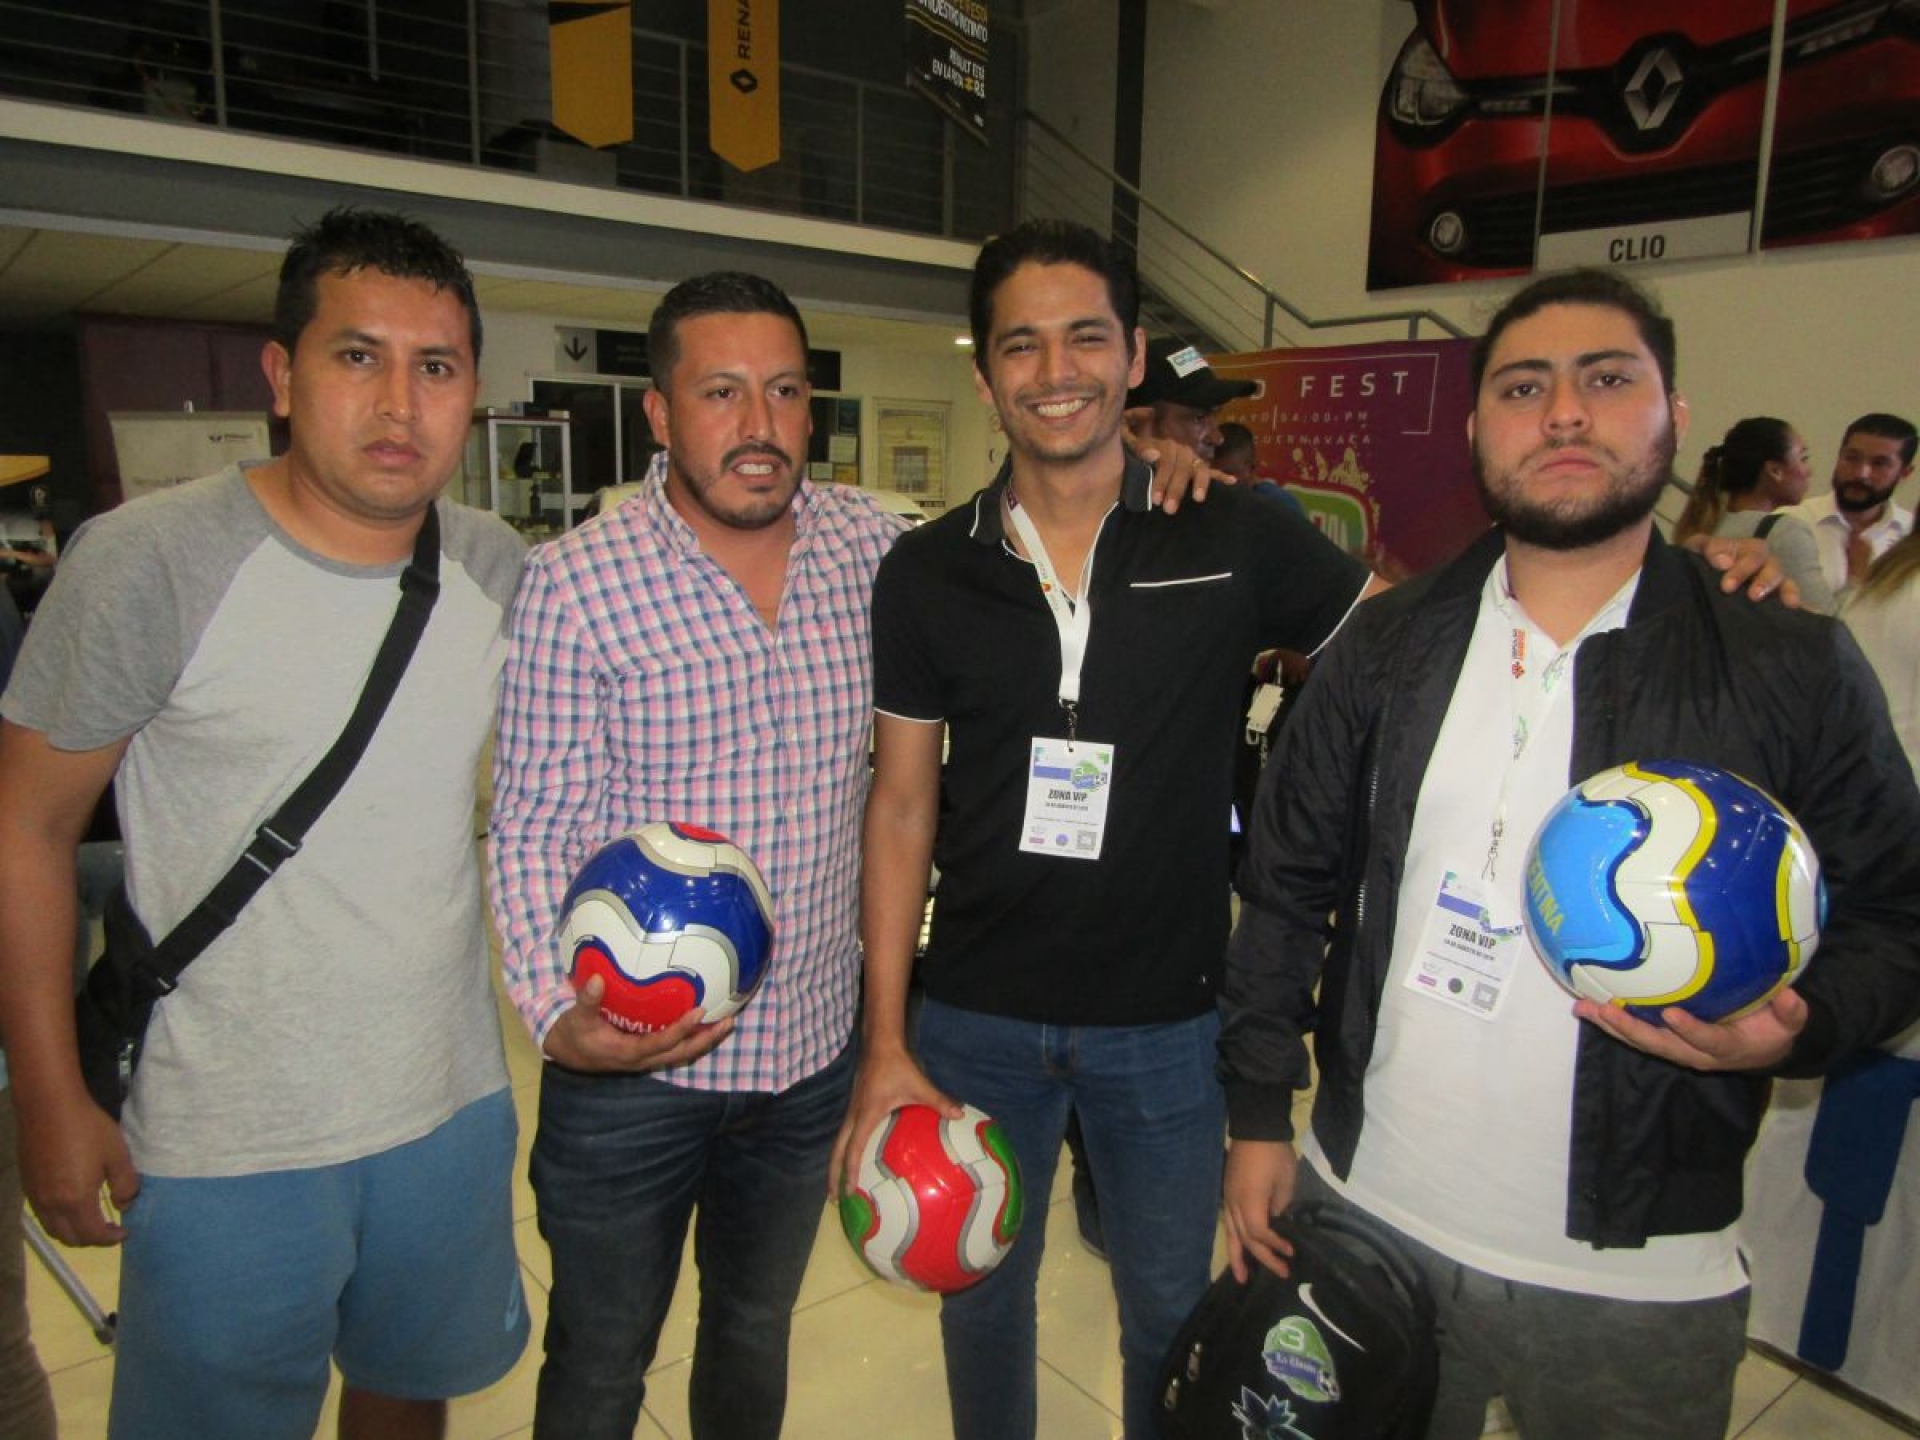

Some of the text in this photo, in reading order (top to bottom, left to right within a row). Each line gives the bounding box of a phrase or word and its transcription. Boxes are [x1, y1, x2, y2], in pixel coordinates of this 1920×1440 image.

[1610, 234, 1665, 262] CLIO
[1300, 370, 1409, 398] FEST
[1048, 789, 1088, 802] ZONA VIP
[1450, 924, 1476, 943] ZONA
[1479, 934, 1496, 949] VIP
